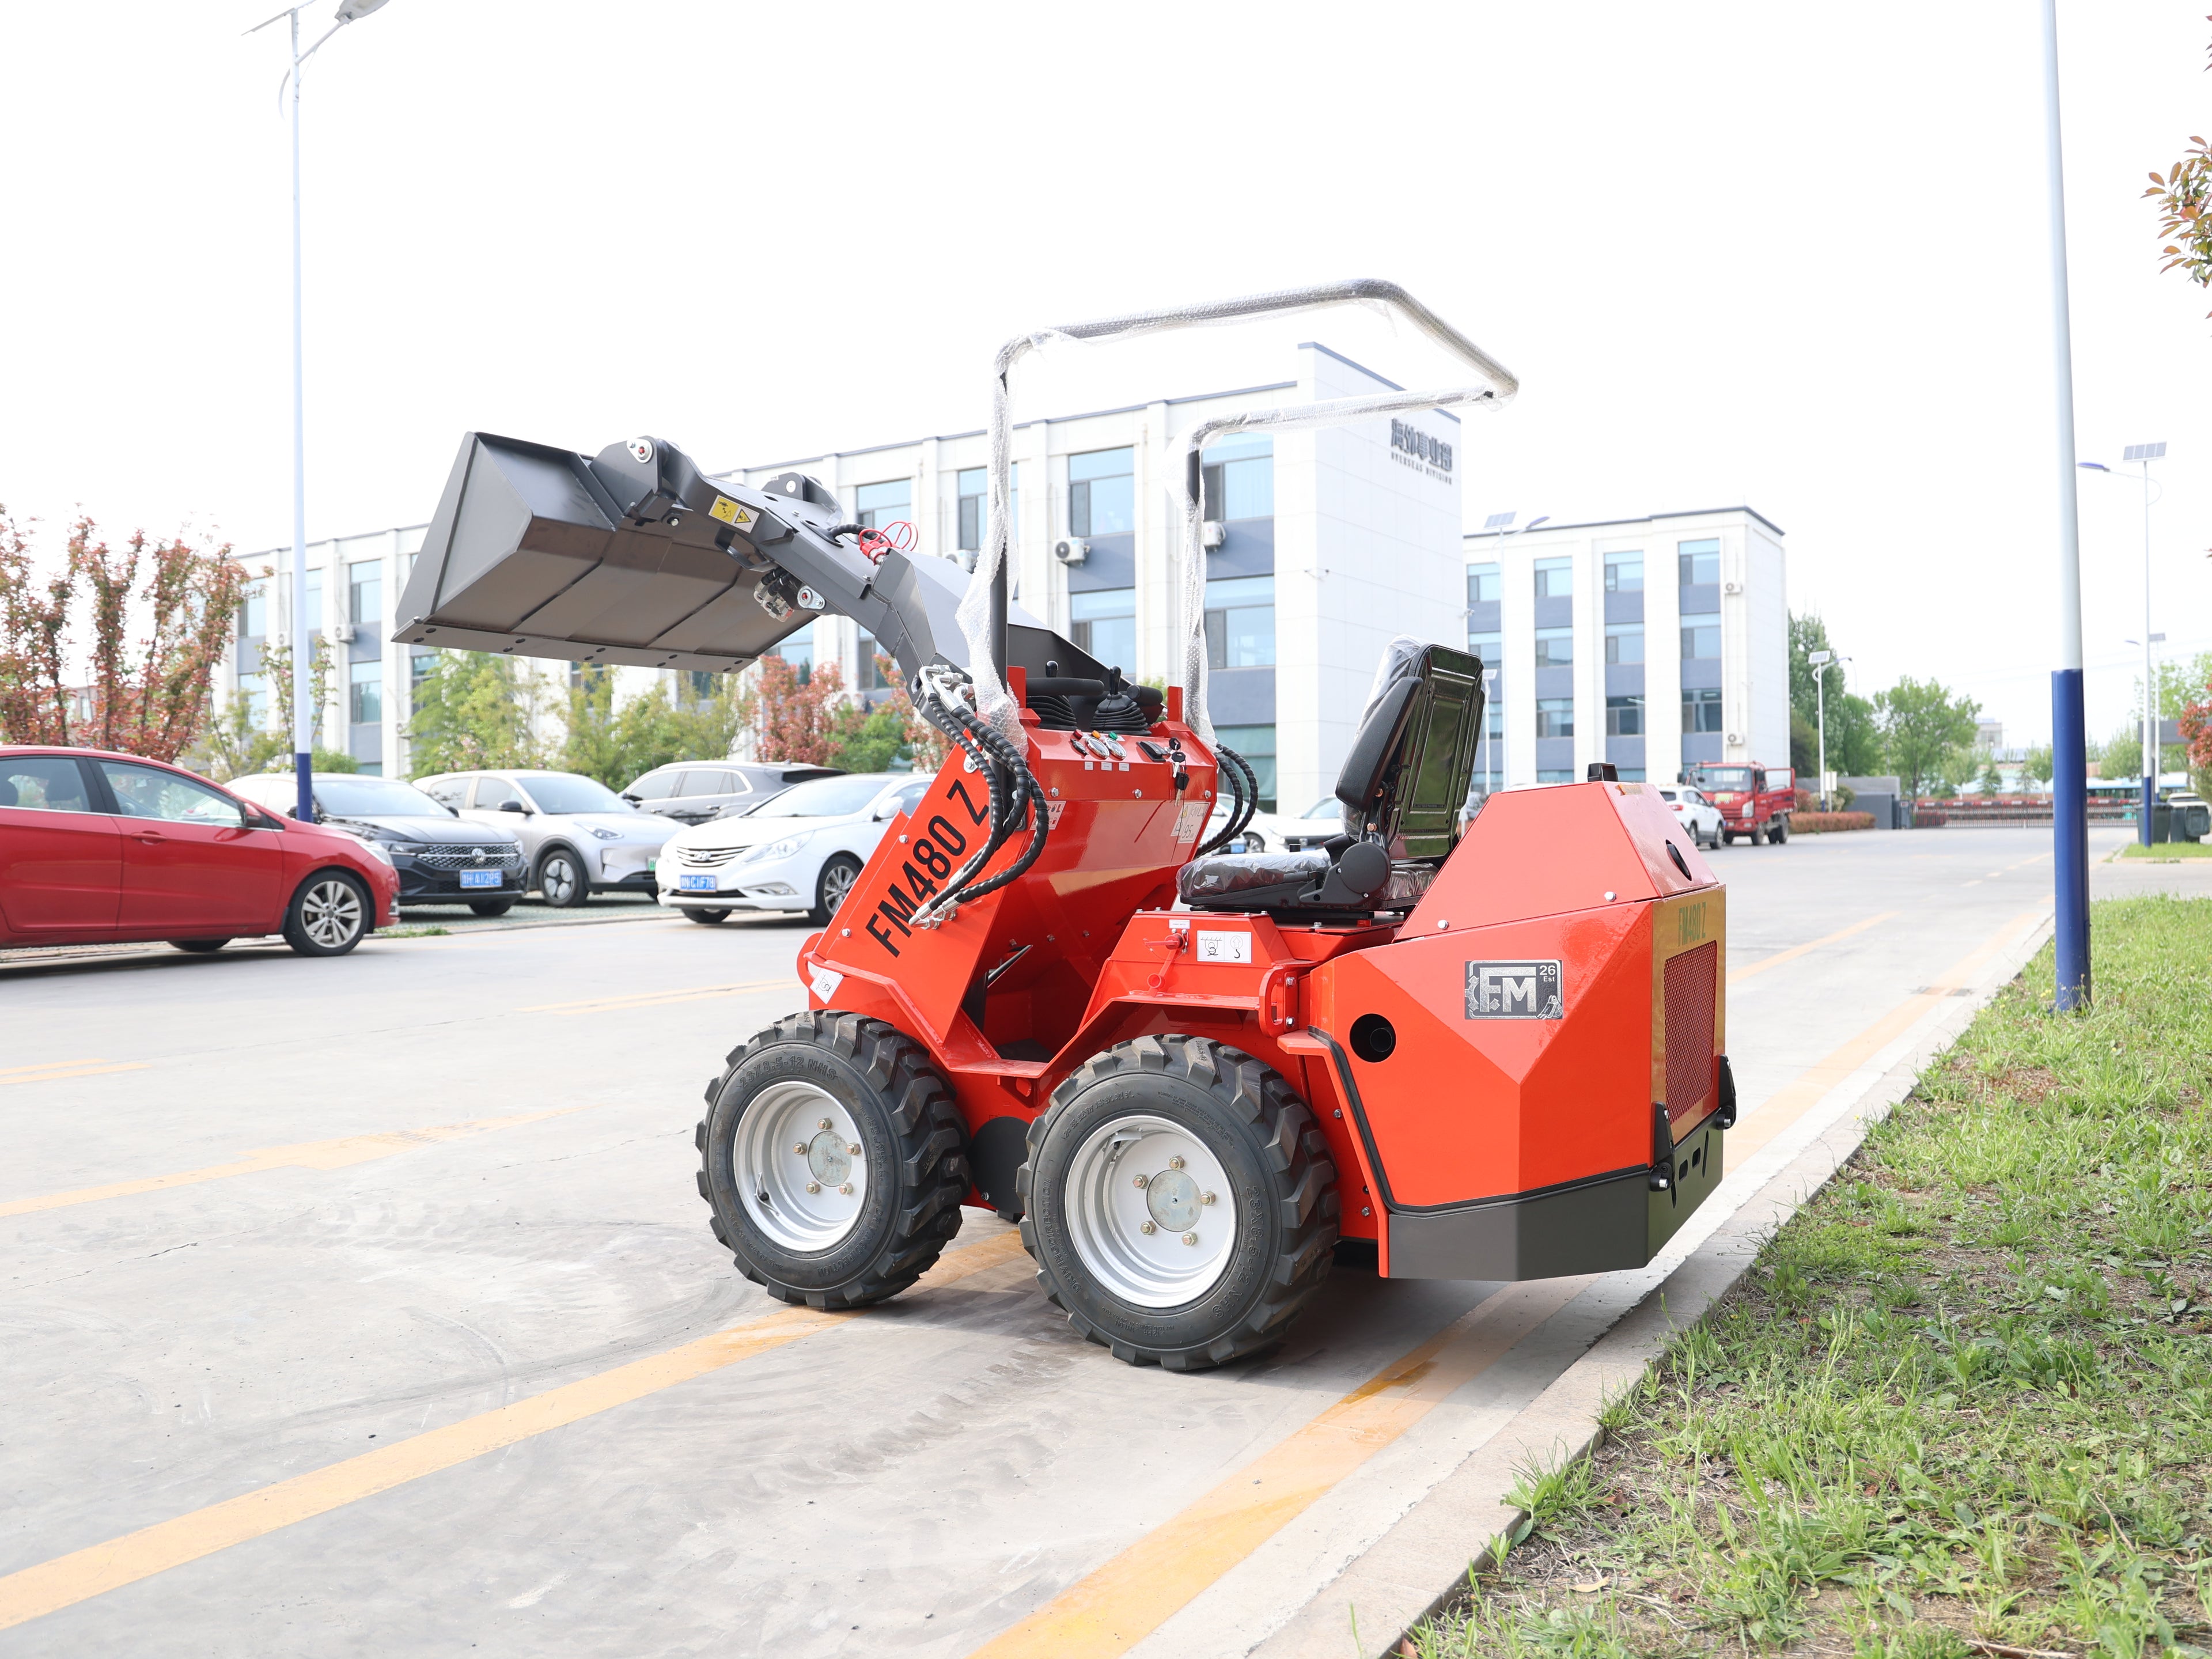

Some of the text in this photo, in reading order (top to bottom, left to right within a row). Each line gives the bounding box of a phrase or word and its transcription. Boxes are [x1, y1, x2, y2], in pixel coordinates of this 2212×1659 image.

[1391, 418, 1452, 472] 海外事业部
[1391, 452, 1452, 486] OVERSEAS DIVISION
[865, 779, 990, 958] FM480 Z
[1479, 967, 1537, 1012] FM
[1539, 965, 1556, 976] 26
[739, 1055, 836, 1088] 23X8.5-12 NHS
[1211, 1185, 1264, 1319] 23X8.5-12 NHS
